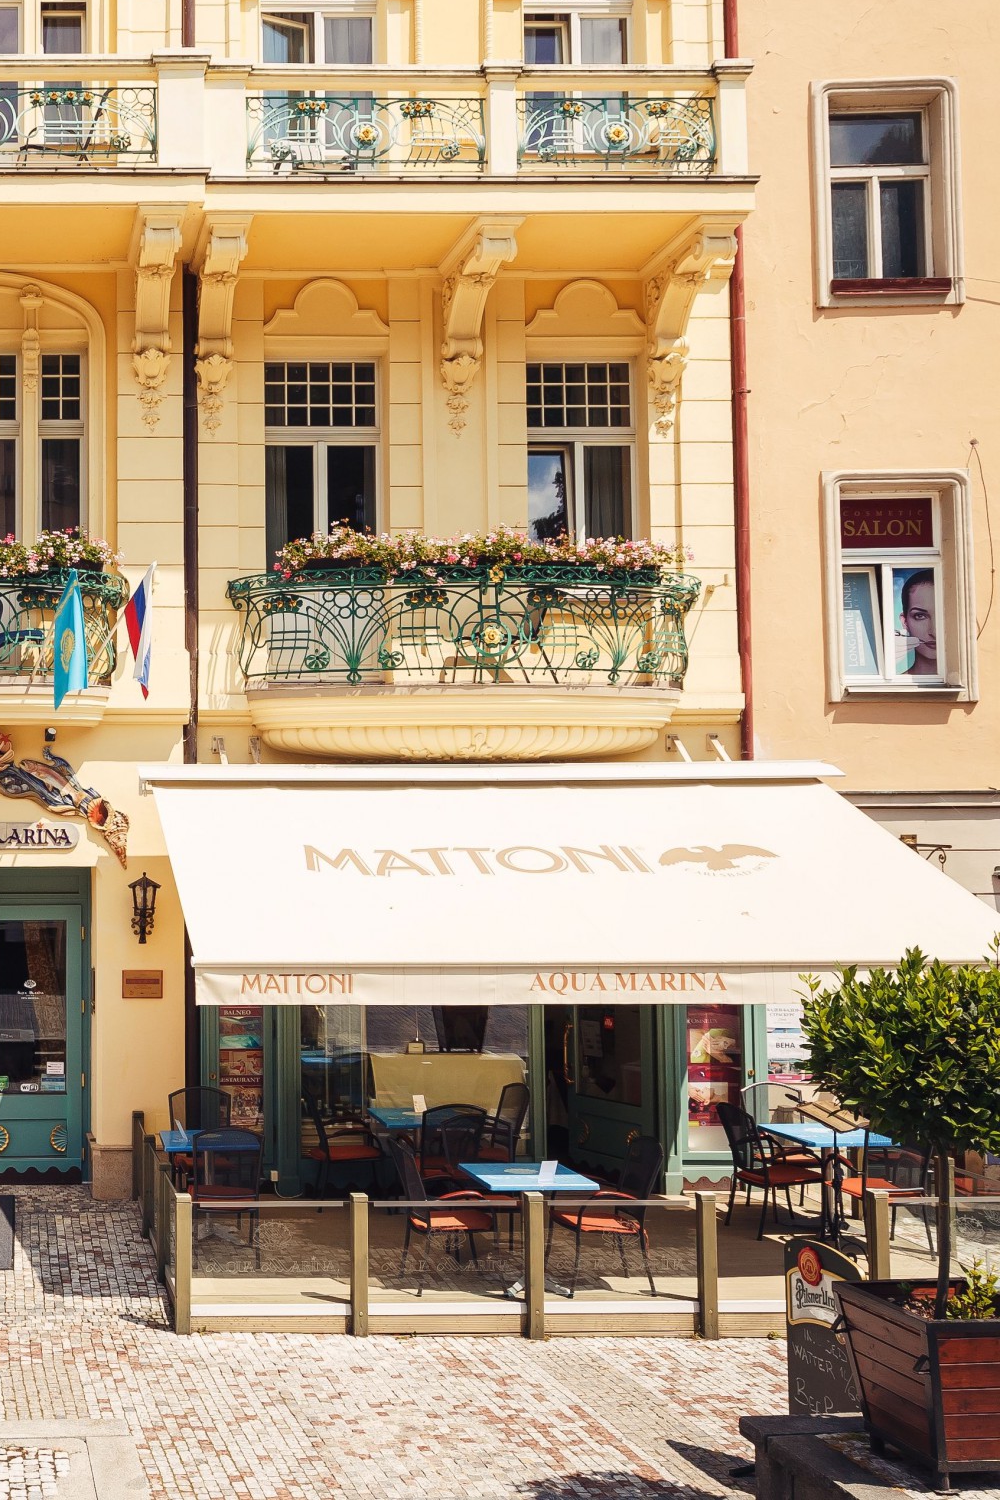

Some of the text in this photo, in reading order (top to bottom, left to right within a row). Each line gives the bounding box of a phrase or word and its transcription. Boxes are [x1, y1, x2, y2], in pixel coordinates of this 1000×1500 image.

[842, 509, 923, 517] COSMETIC
[843, 519, 923, 537] SALON
[302, 844, 656, 878] MATTONI
[241, 973, 354, 994] MATTONI
[529, 972, 728, 996] AQUA MARINA
[796, 1278, 822, 1309] Pilsner
